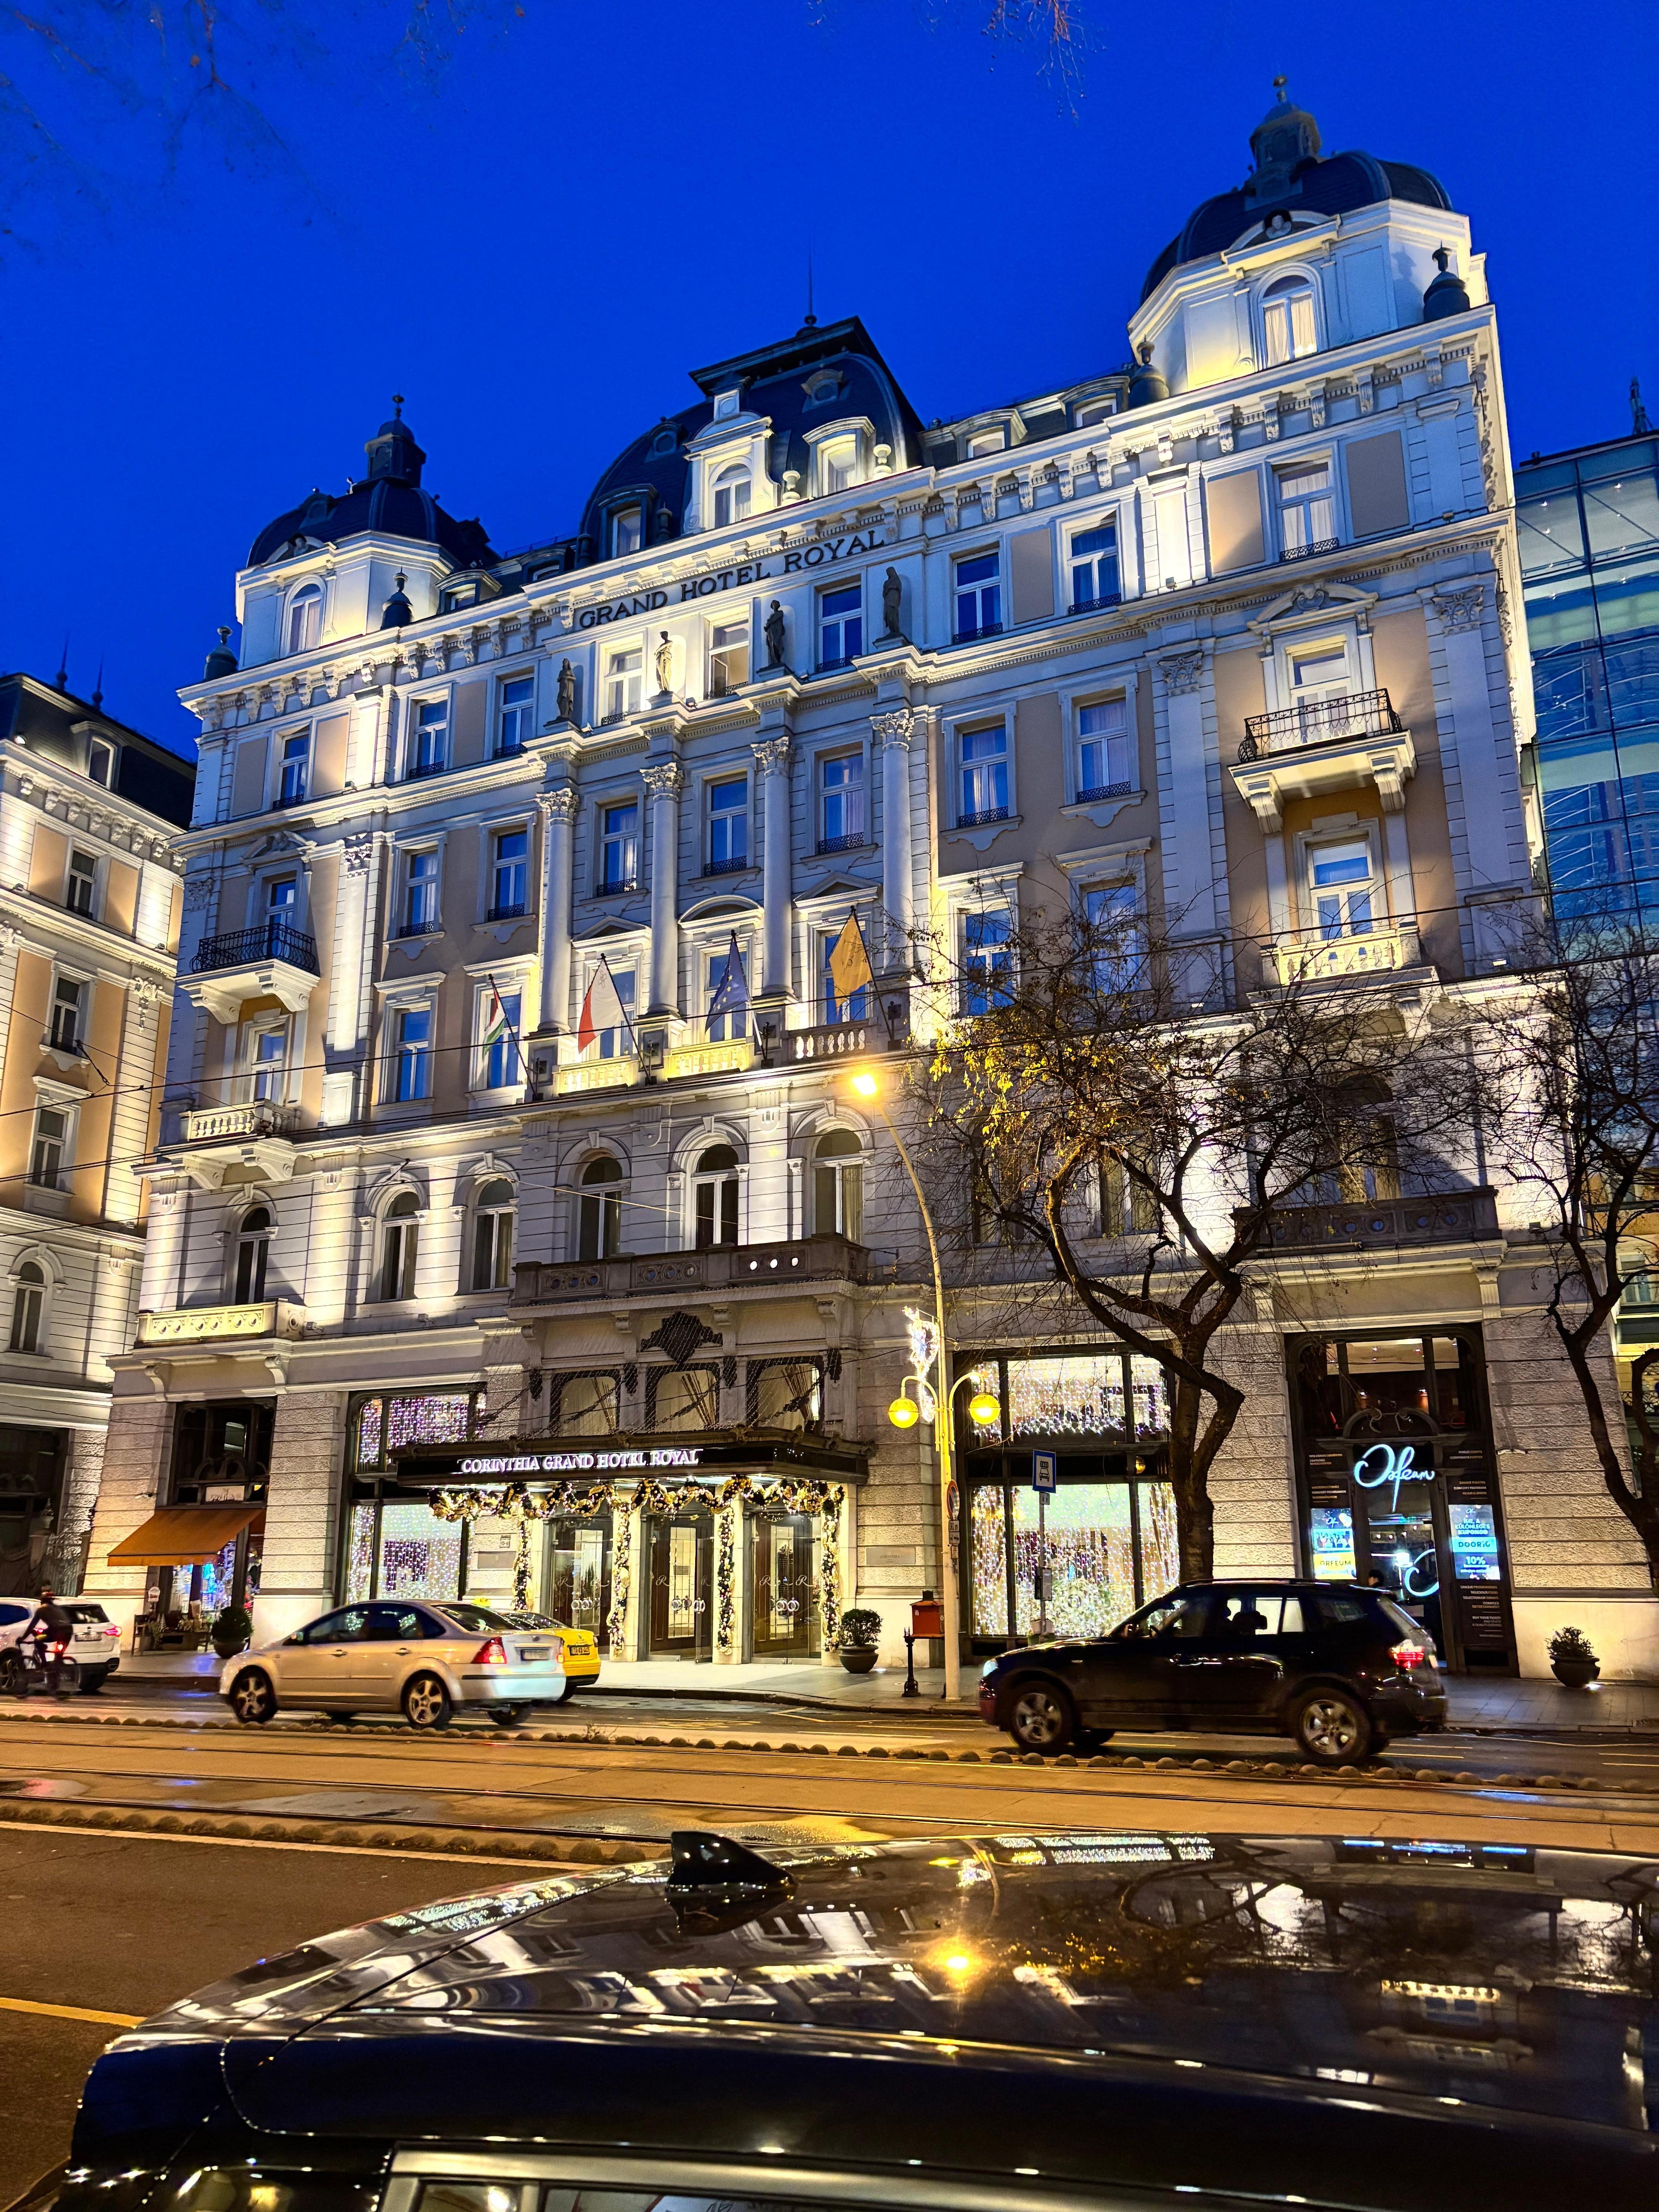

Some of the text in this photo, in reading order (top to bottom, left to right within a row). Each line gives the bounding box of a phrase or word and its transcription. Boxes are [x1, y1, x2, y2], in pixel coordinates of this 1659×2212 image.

[579, 530, 884, 629] GRAND HOTEL ROYAL
[463, 1450, 699, 1473] CORINTHIA GRAND HOTEL ROYAL
[1466, 1556, 1486, 1565] 10%
